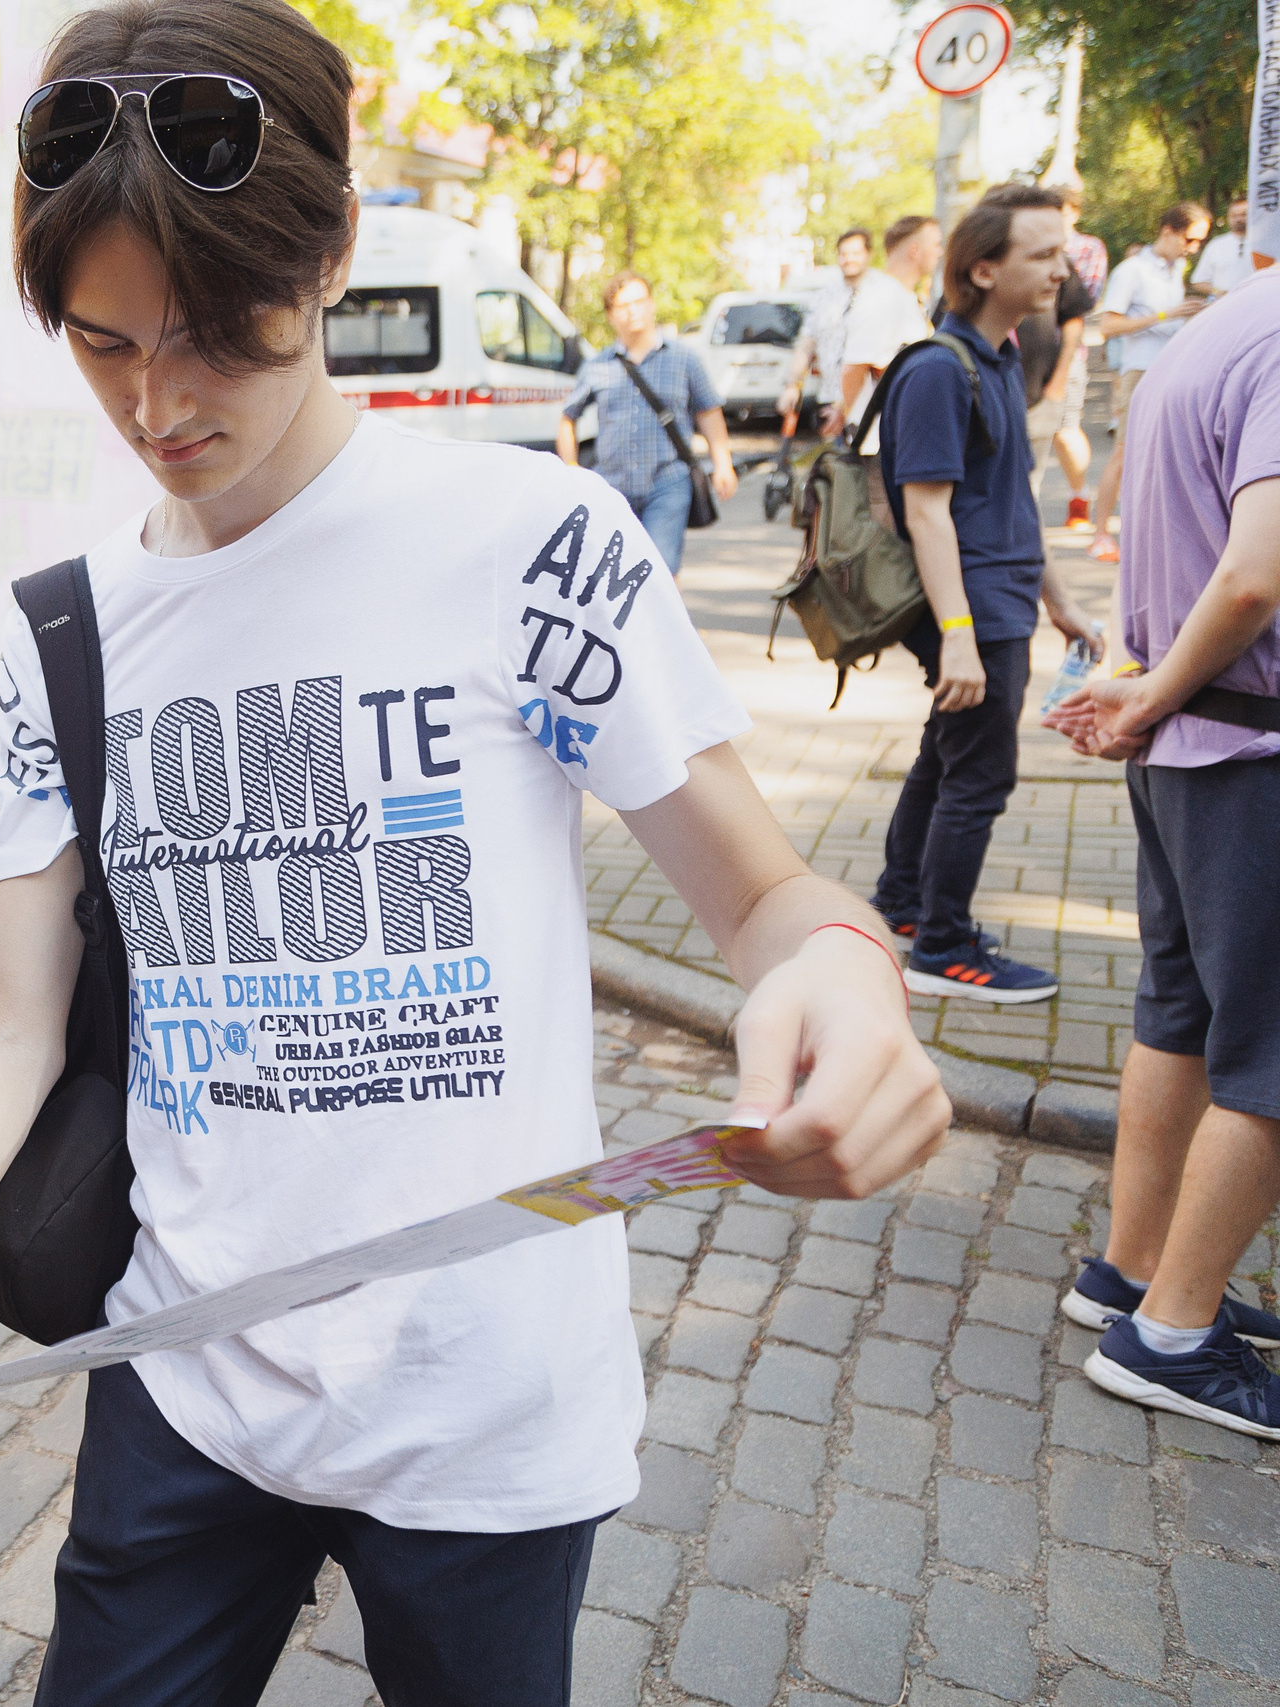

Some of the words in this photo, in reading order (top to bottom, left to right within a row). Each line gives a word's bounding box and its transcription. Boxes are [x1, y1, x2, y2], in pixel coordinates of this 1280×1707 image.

[936, 32, 988, 67] 40
[1256, 179, 1279, 213] ИГР
[522, 503, 653, 631] AM
[517, 606, 622, 706] TD
[104, 675, 350, 849] TOM
[358, 685, 461, 782] TE
[101, 802, 371, 879] International
[108, 834, 473, 968] AILOR
[135, 975, 213, 1010] NAL
[222, 973, 324, 1009] DENIM
[332, 956, 491, 1006] BRAND
[259, 1007, 387, 1038] GENUINE
[398, 996, 499, 1027] CRAFT
[256, 1064, 280, 1082] THE
[282, 1059, 380, 1082] OUTDOOR
[383, 1048, 506, 1072] ADVENTURE
[348, 1031, 441, 1058] FASHION
[208, 1081, 286, 1113] GENERAL
[290, 1077, 405, 1114] PURPOSE
[410, 1070, 505, 1102] UTILITY
